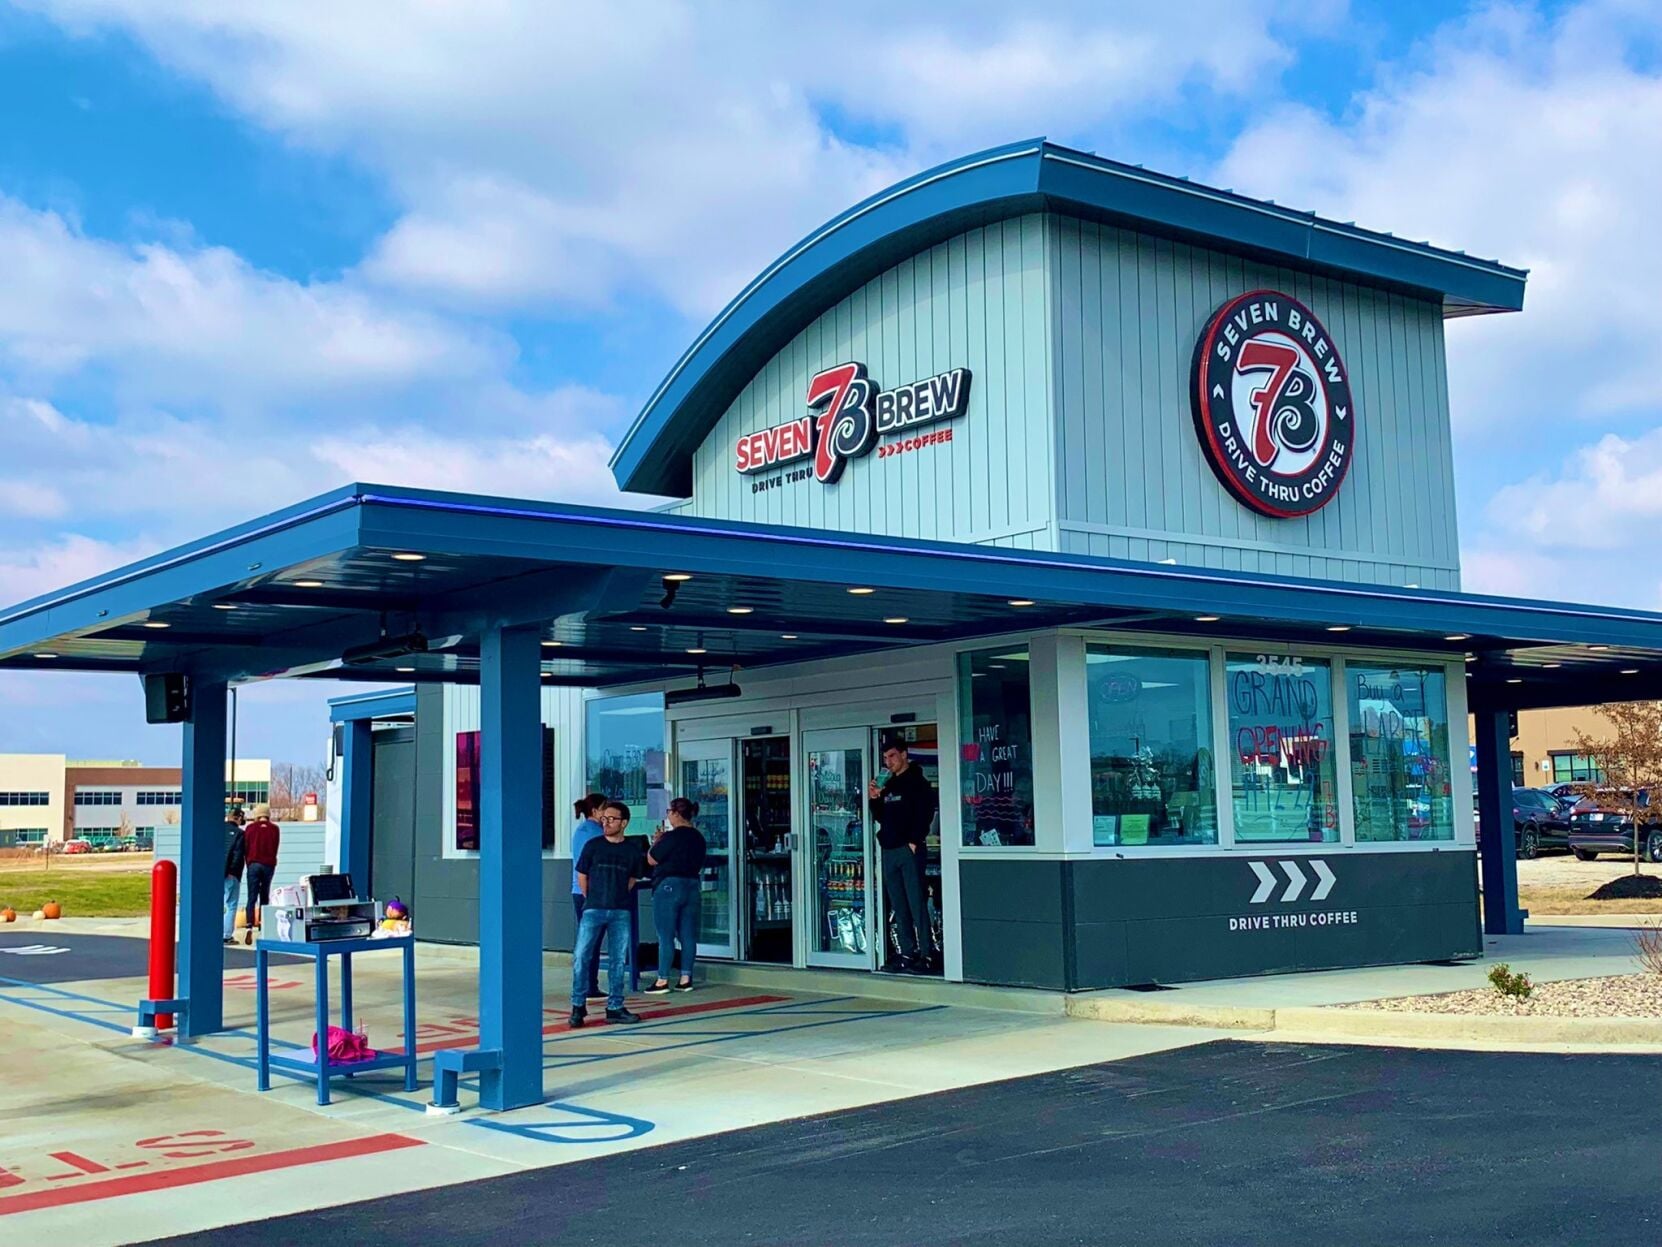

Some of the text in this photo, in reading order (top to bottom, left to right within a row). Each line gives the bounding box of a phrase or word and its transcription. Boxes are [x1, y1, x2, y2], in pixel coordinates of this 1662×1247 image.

[1216, 301, 1343, 383] SEVEN BREW
[735, 417, 812, 473] SEVEN
[875, 367, 964, 433] BREW
[751, 428, 953, 495] DRIVE THRU COFFEE
[1218, 421, 1345, 502] DRIVE THRU COFFEE
[1256, 654, 1304, 677] 3545
[1234, 670, 1318, 720] GRAND
[1357, 673, 1385, 710] Buy
[978, 724, 1000, 742] HAVE
[980, 744, 1018, 762] A GREAT
[1229, 911, 1358, 931] DRIVE THRU COFFEE
